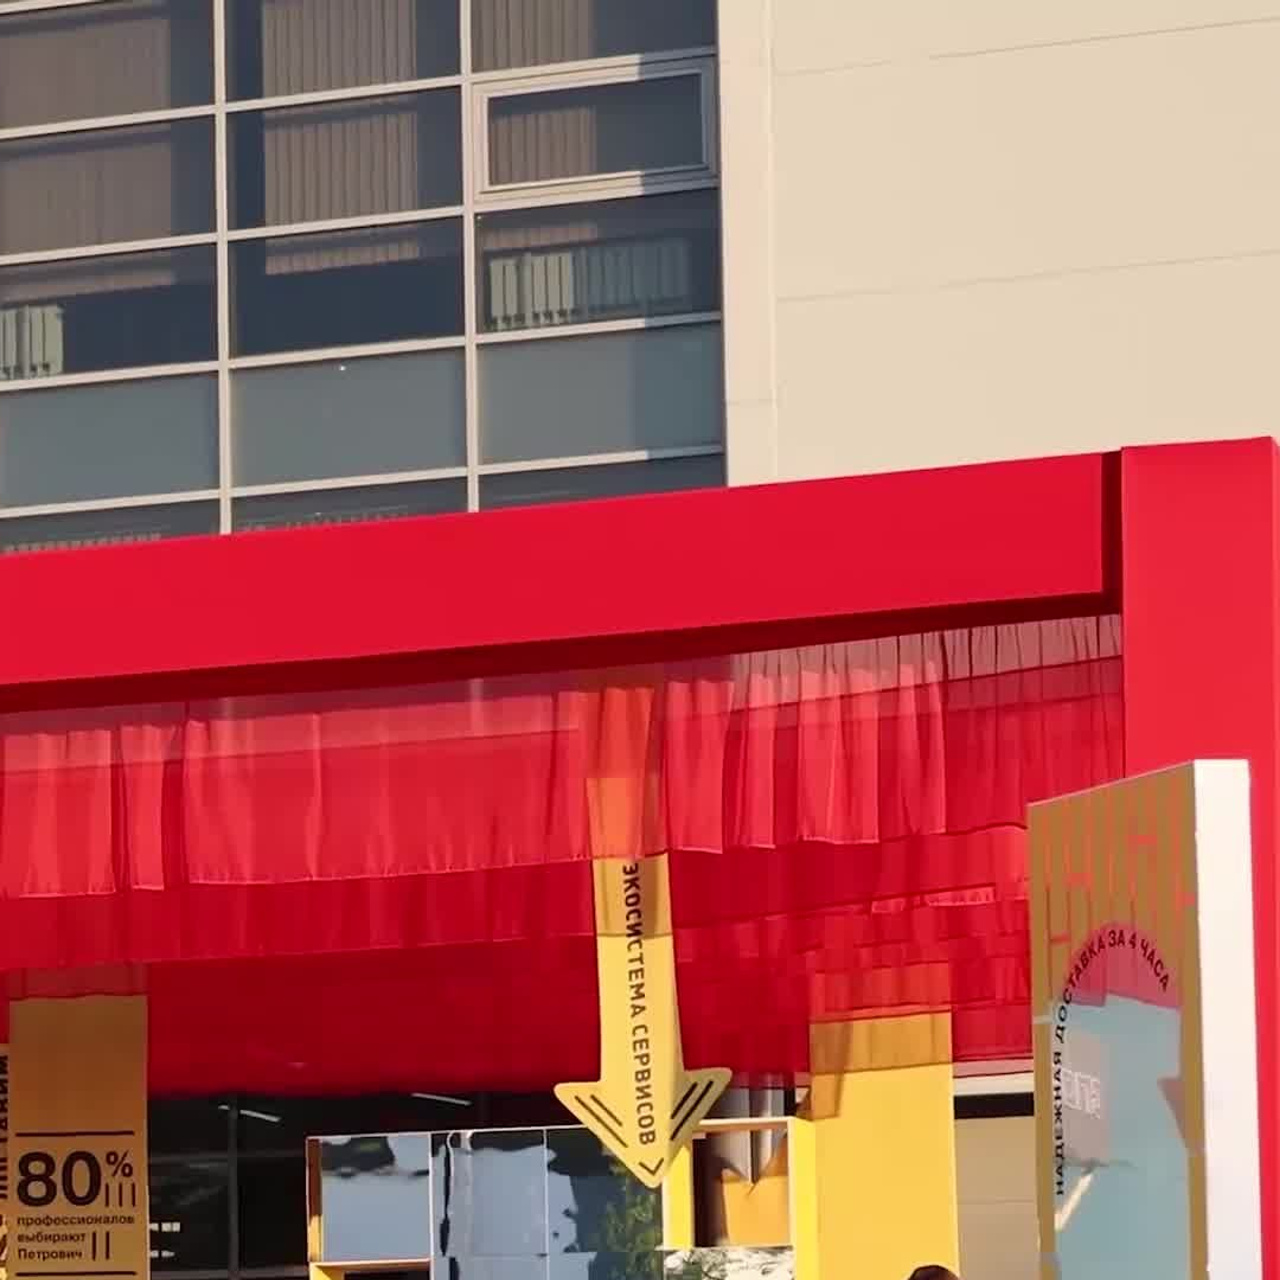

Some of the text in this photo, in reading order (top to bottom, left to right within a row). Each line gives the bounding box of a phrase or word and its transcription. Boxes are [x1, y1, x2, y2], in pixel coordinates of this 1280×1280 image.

[622, 862, 656, 1145] ЭКОСИСТЕМА СЕРВИСОВ
[1055, 936, 1106, 1044] ДОСТАВКА
[1108, 929, 1125, 947] ЗА
[1128, 931, 1138, 949] 4
[1140, 938, 1170, 992] ЧАСА
[17, 1150, 134, 1207] 80%
[17, 1214, 135, 1227] профессионалов
[17, 1232, 86, 1244] выбирают
[18, 1248, 83, 1261] Петрович
